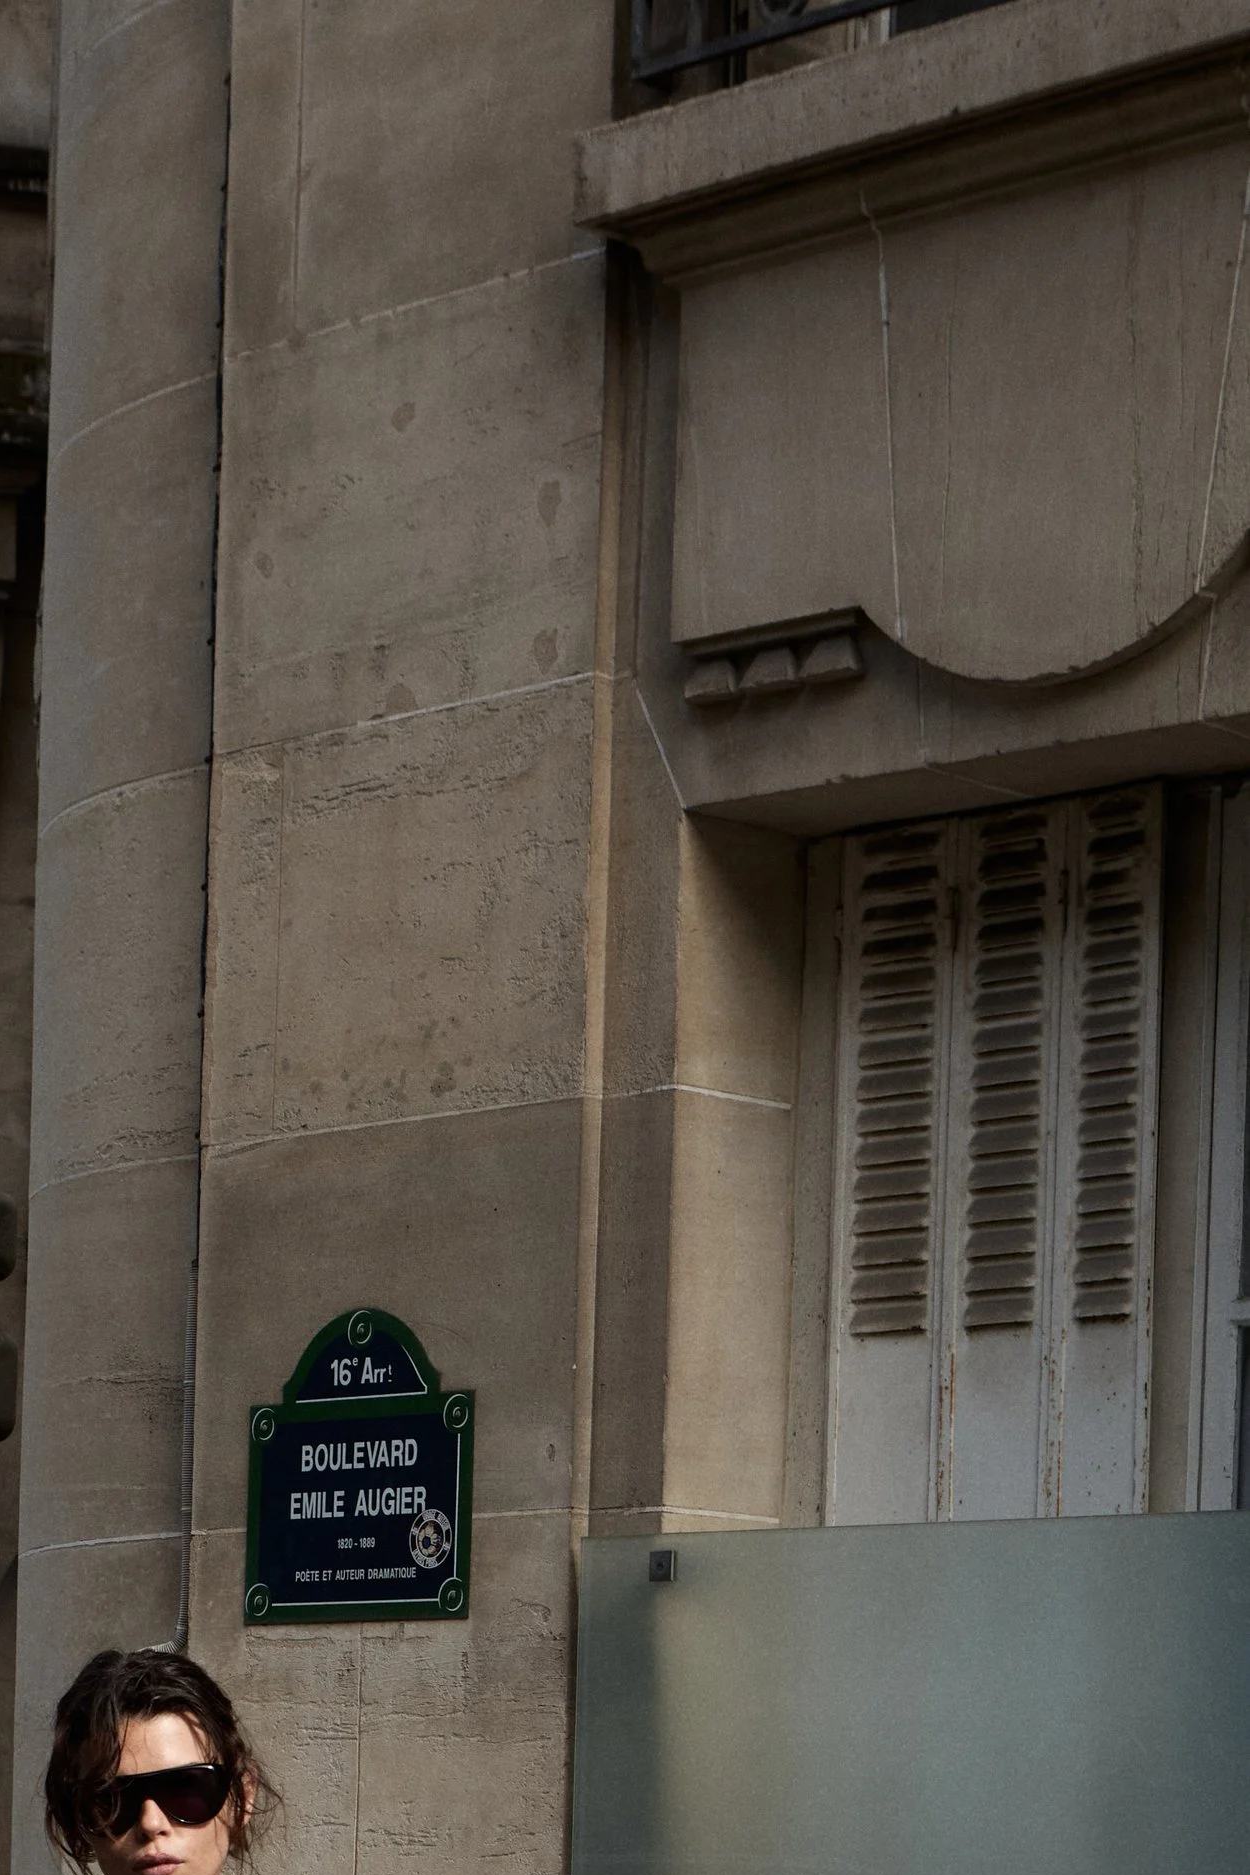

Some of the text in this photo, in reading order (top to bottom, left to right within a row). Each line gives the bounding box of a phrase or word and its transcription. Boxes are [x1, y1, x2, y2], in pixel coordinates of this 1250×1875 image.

[301, 1438, 418, 1472] BOULEVARD
[290, 1485, 427, 1520] EMILE AUGIER
[295, 1567, 417, 1582] POÈTE ET AUTEUR DRAMATIQUE
